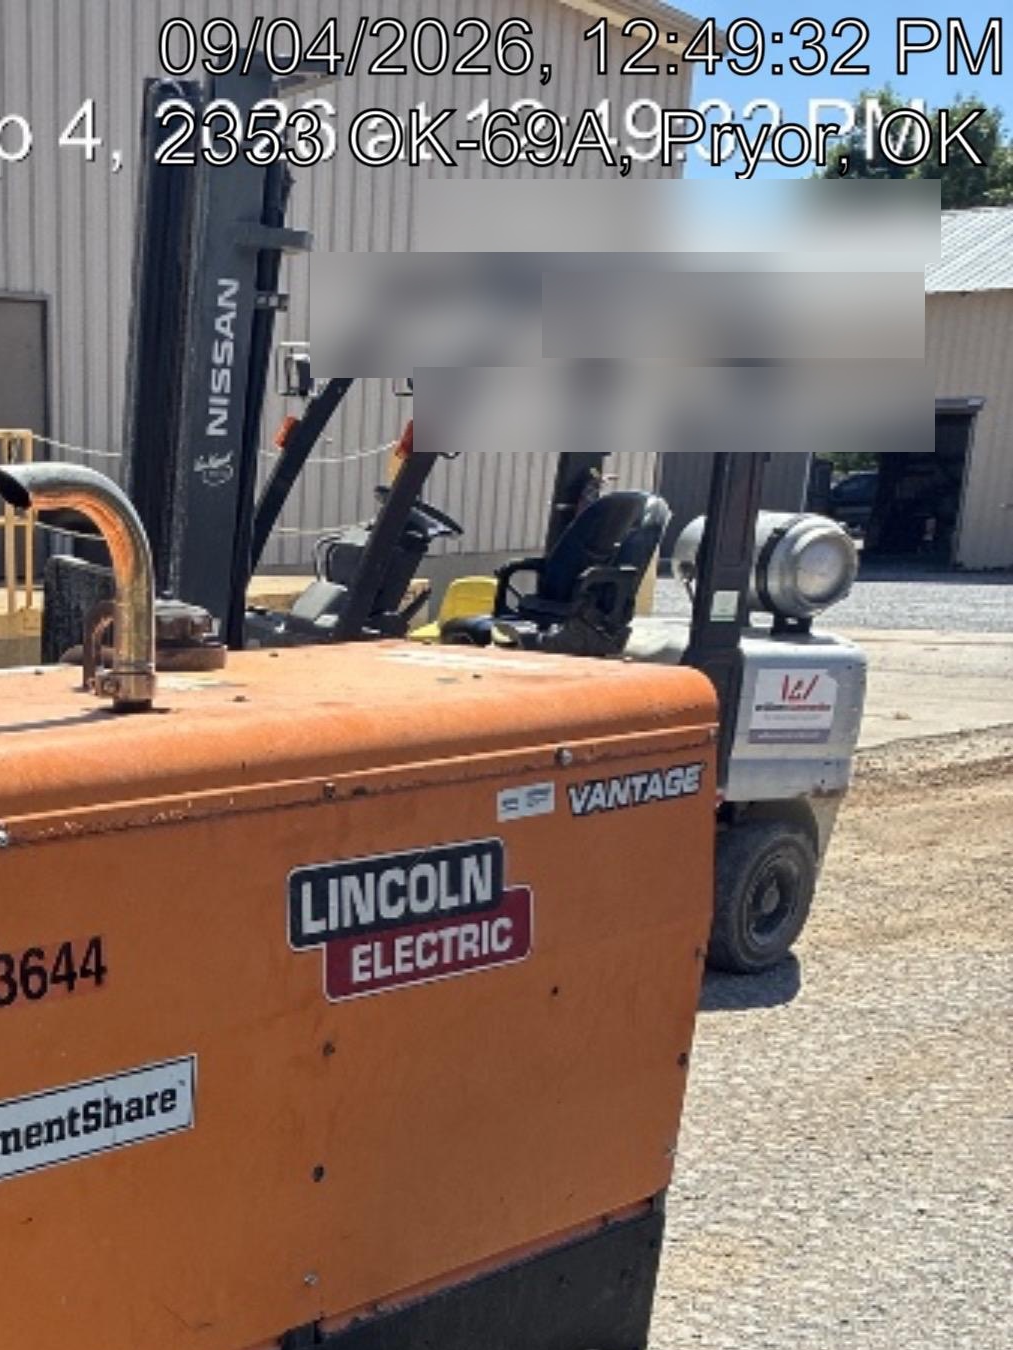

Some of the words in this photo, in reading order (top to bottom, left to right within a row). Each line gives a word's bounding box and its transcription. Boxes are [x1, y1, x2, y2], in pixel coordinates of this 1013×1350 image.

[186, 278, 240, 437] NISSAN
[568, 763, 704, 817] VANTAGE
[300, 853, 493, 936] LINCOLN
[351, 916, 514, 984] ELECTRIC
